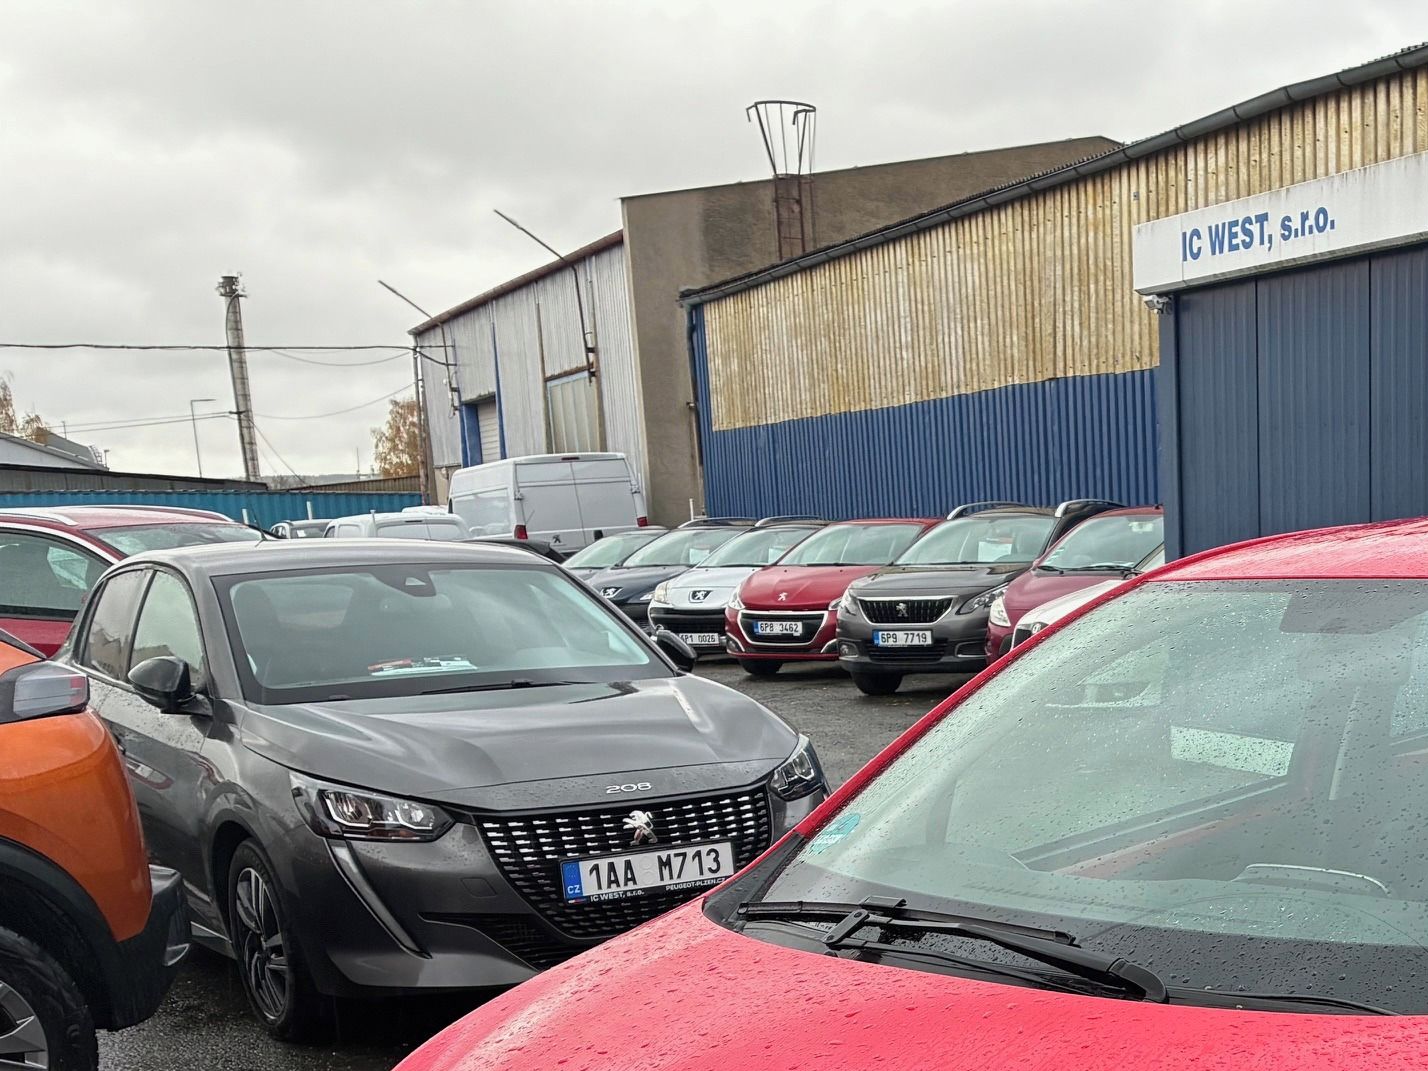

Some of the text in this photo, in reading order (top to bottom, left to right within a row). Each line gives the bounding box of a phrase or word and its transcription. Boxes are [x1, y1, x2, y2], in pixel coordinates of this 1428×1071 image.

[1181, 206, 1336, 263] IC WEST, s.r.o.
[760, 622, 799, 633] 6P8 3462
[880, 632, 927, 644] 6P9 7719
[606, 782, 652, 794] 208
[588, 847, 721, 891] 1AA M713
[567, 884, 581, 895] CZ
[600, 890, 626, 901] WEST,
